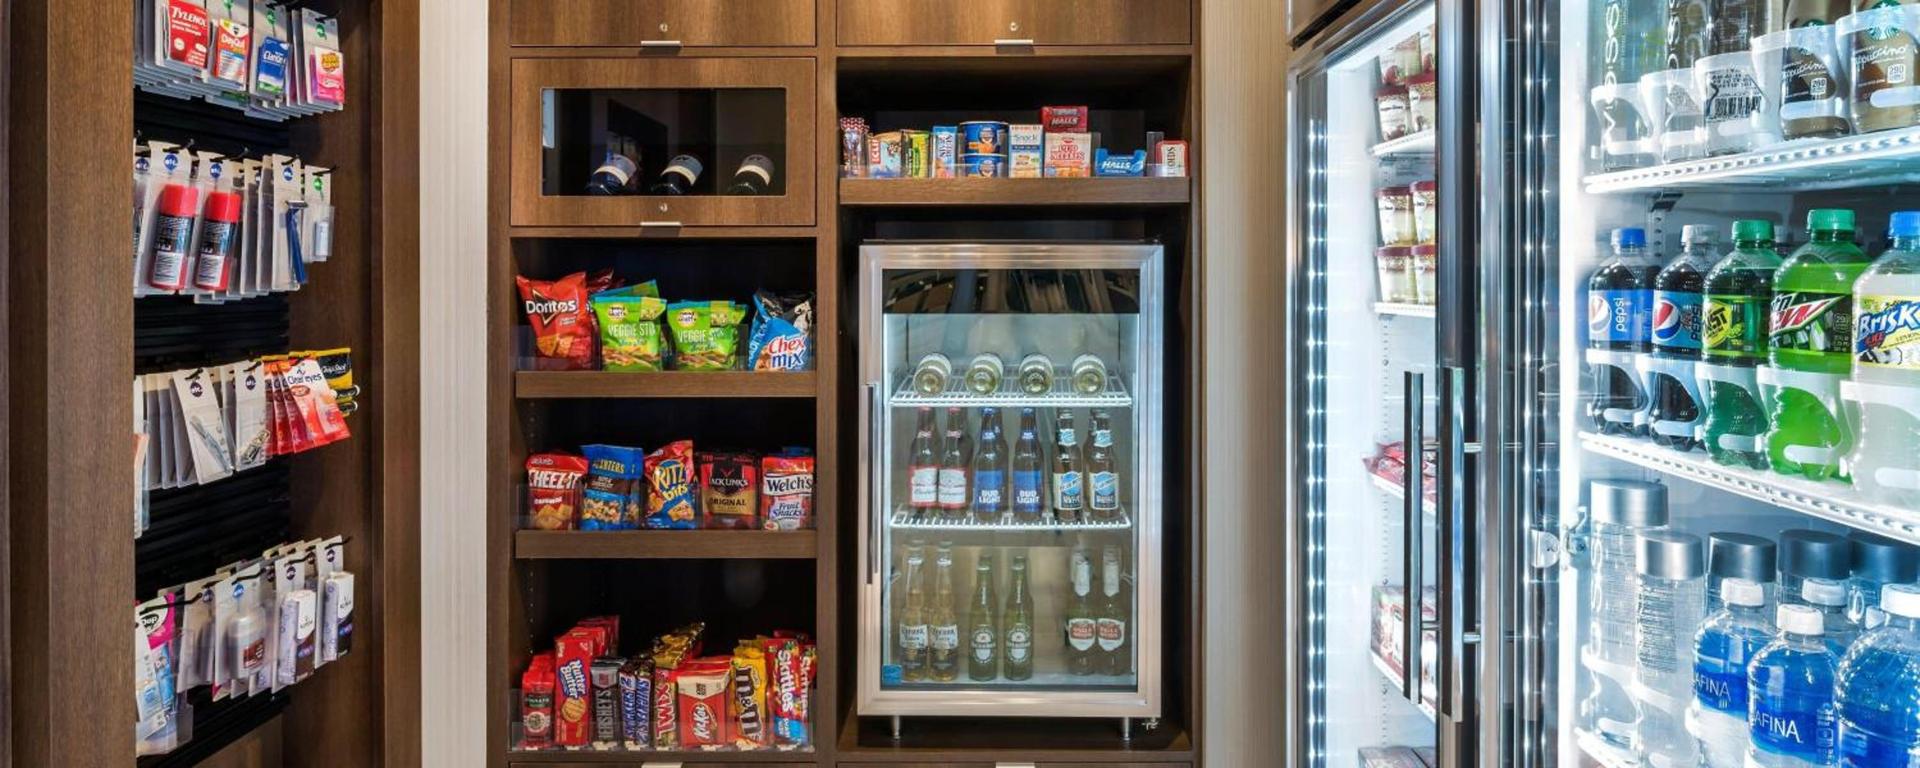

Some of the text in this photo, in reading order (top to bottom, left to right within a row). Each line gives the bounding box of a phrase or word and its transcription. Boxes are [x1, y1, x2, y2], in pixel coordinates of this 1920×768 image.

[1051, 117, 1079, 126] HALLS
[1101, 160, 1131, 170] HALLS
[525, 299, 577, 315] Doritos
[1615, 297, 1628, 333] pepsi
[608, 323, 637, 337] VEGGIE
[678, 330, 706, 343] VEGGIE
[768, 336, 804, 354] Chex
[654, 464, 687, 493] RITZ
[766, 476, 813, 492] Welch's
[663, 484, 688, 501] bits
[978, 496, 1001, 504] LIGHT
[1016, 496, 1040, 504] LIGHT
[559, 665, 579, 699] Butter
[569, 659, 588, 698] Nutter
[777, 649, 794, 713] Skittles
[1695, 673, 1732, 702] AFINA
[596, 690, 613, 739] HERSHEY'S
[655, 684, 675, 740] TWIX
[1755, 709, 1804, 744] AFINA
